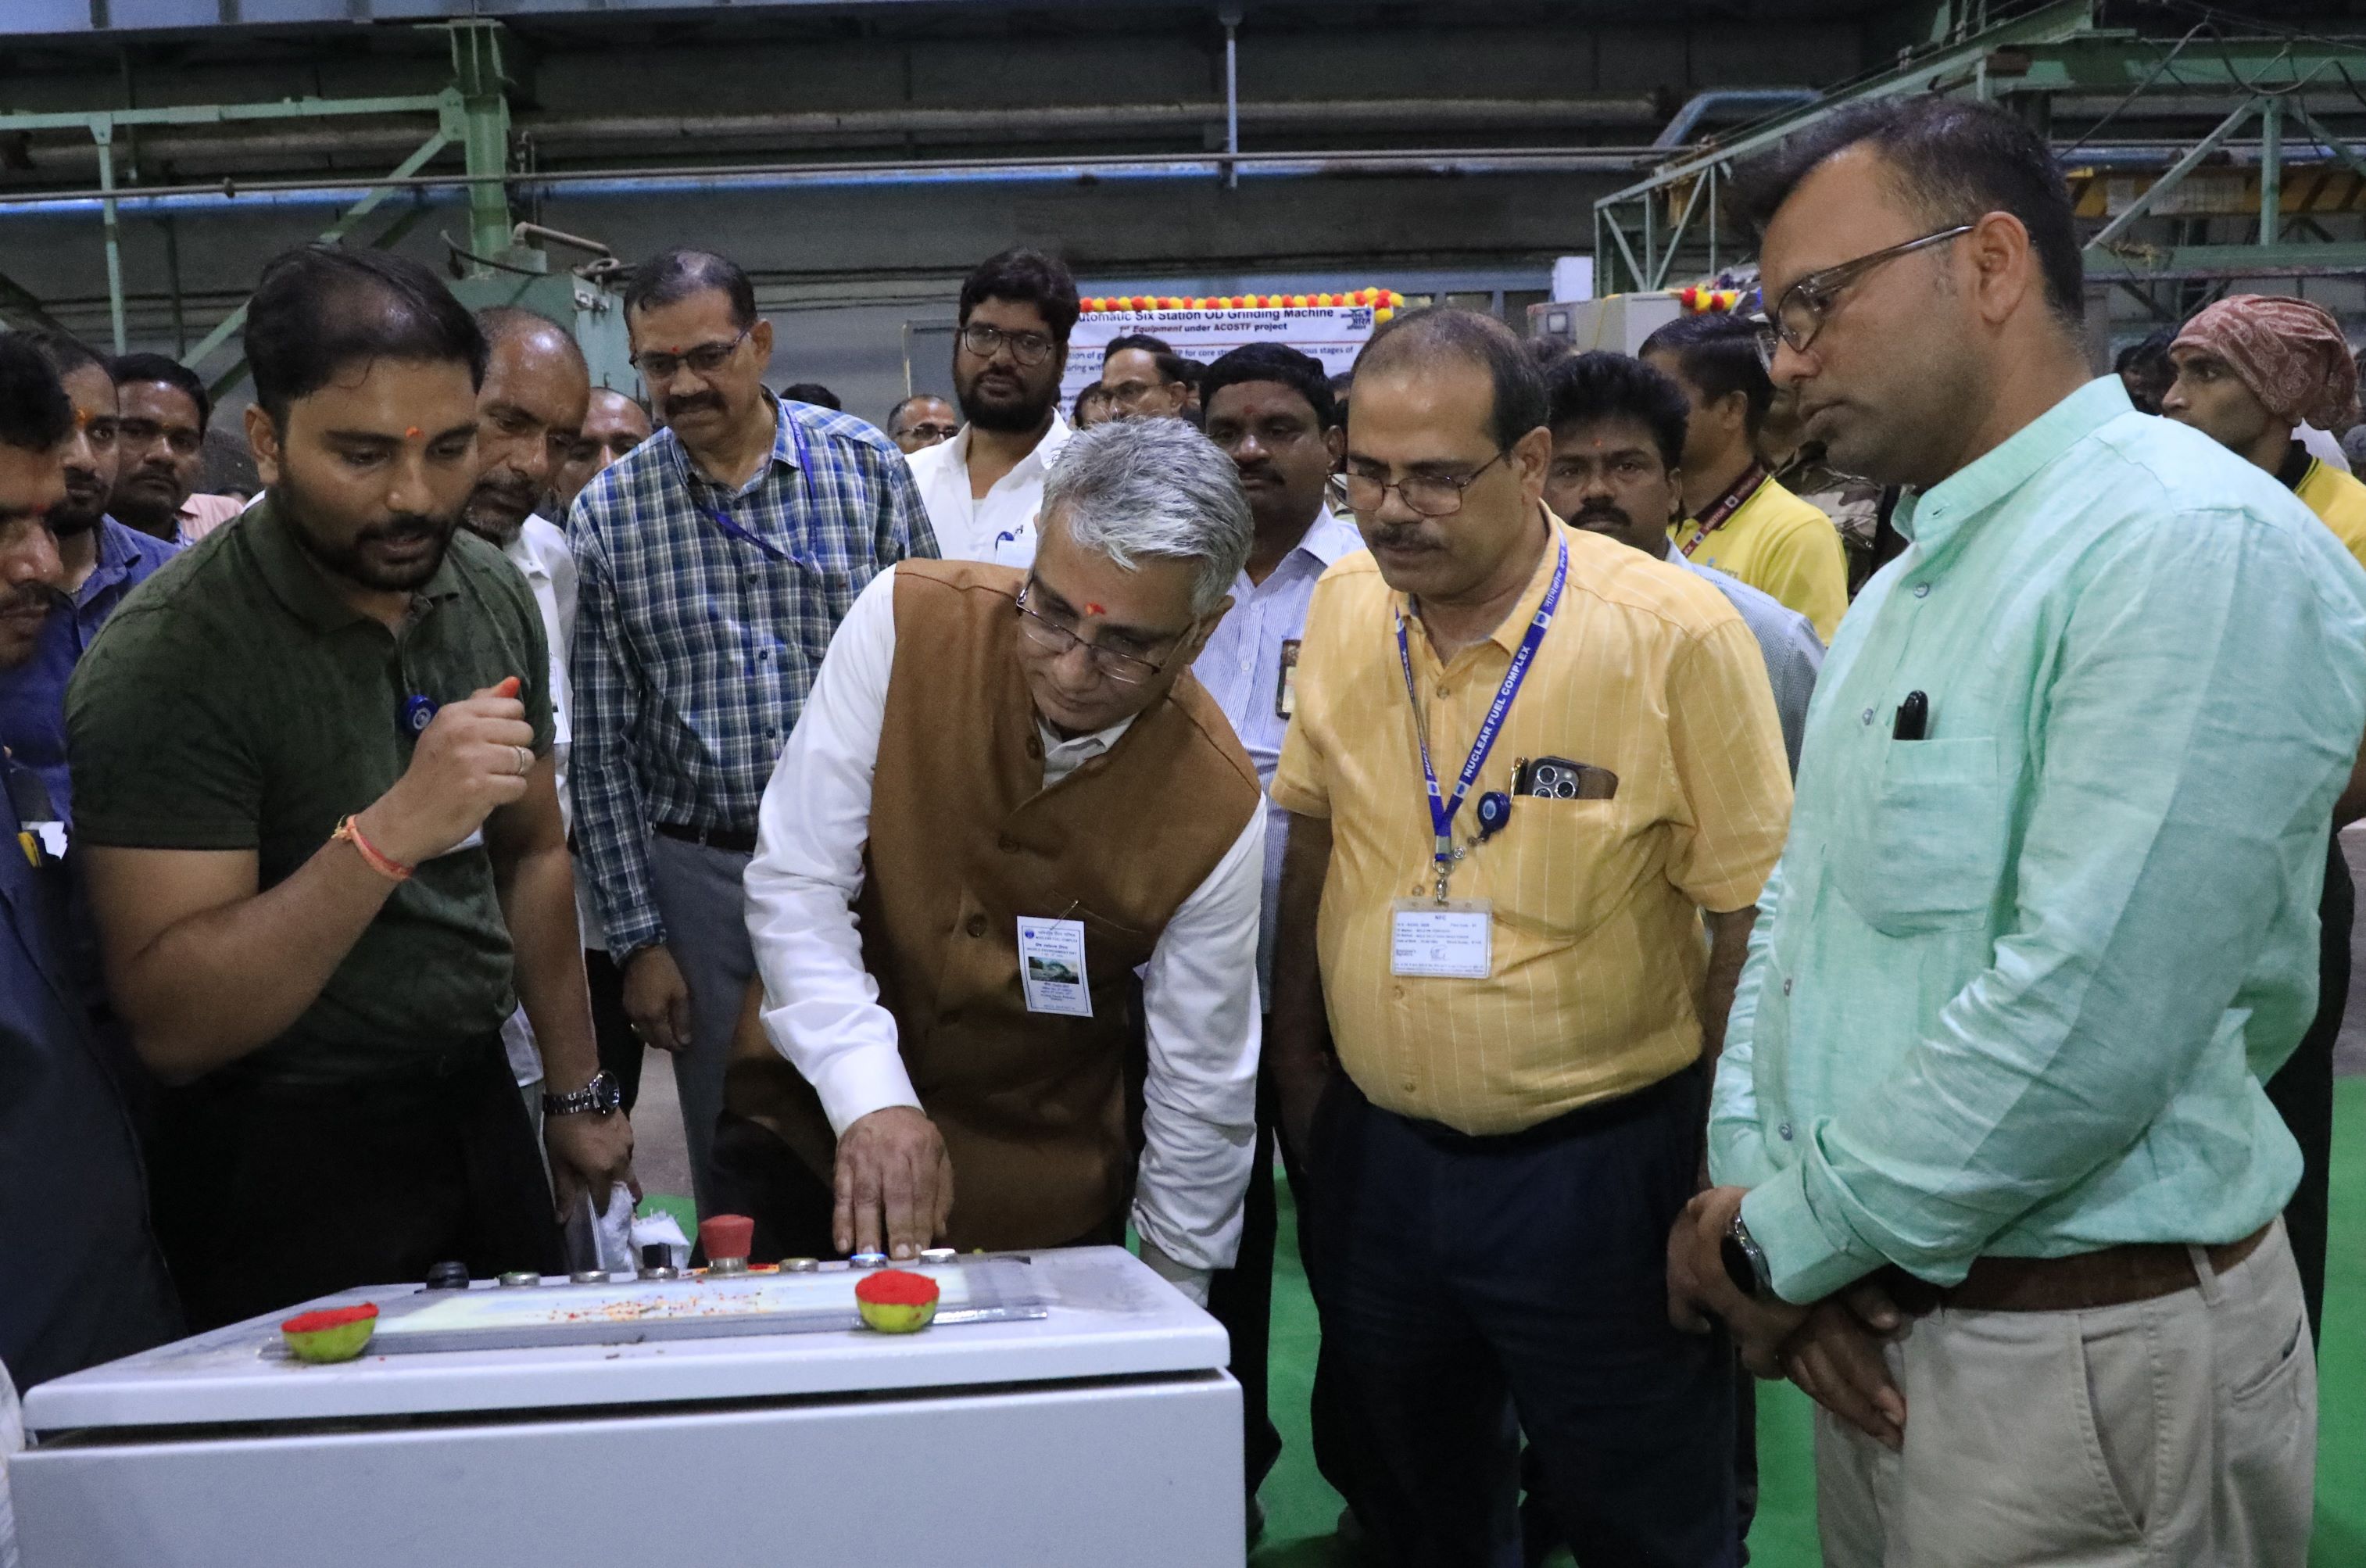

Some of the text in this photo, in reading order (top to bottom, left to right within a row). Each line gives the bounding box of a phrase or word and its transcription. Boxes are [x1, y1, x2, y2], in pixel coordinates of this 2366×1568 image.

[1078, 312, 1131, 322] utomatic
[1136, 310, 1154, 320] Six
[1158, 310, 1201, 320] Station
[1205, 310, 1224, 320] OD
[1228, 309, 1280, 320] Grinding
[1284, 308, 1333, 317] Machine
[1133, 324, 1182, 333] Equipment
[1254, 323, 1287, 331] project
[1320, 347, 1344, 356] stages
[1066, 364, 1086, 373] uring
[1463, 645, 1531, 778] NUCLEAR FUEL COMPLEX
